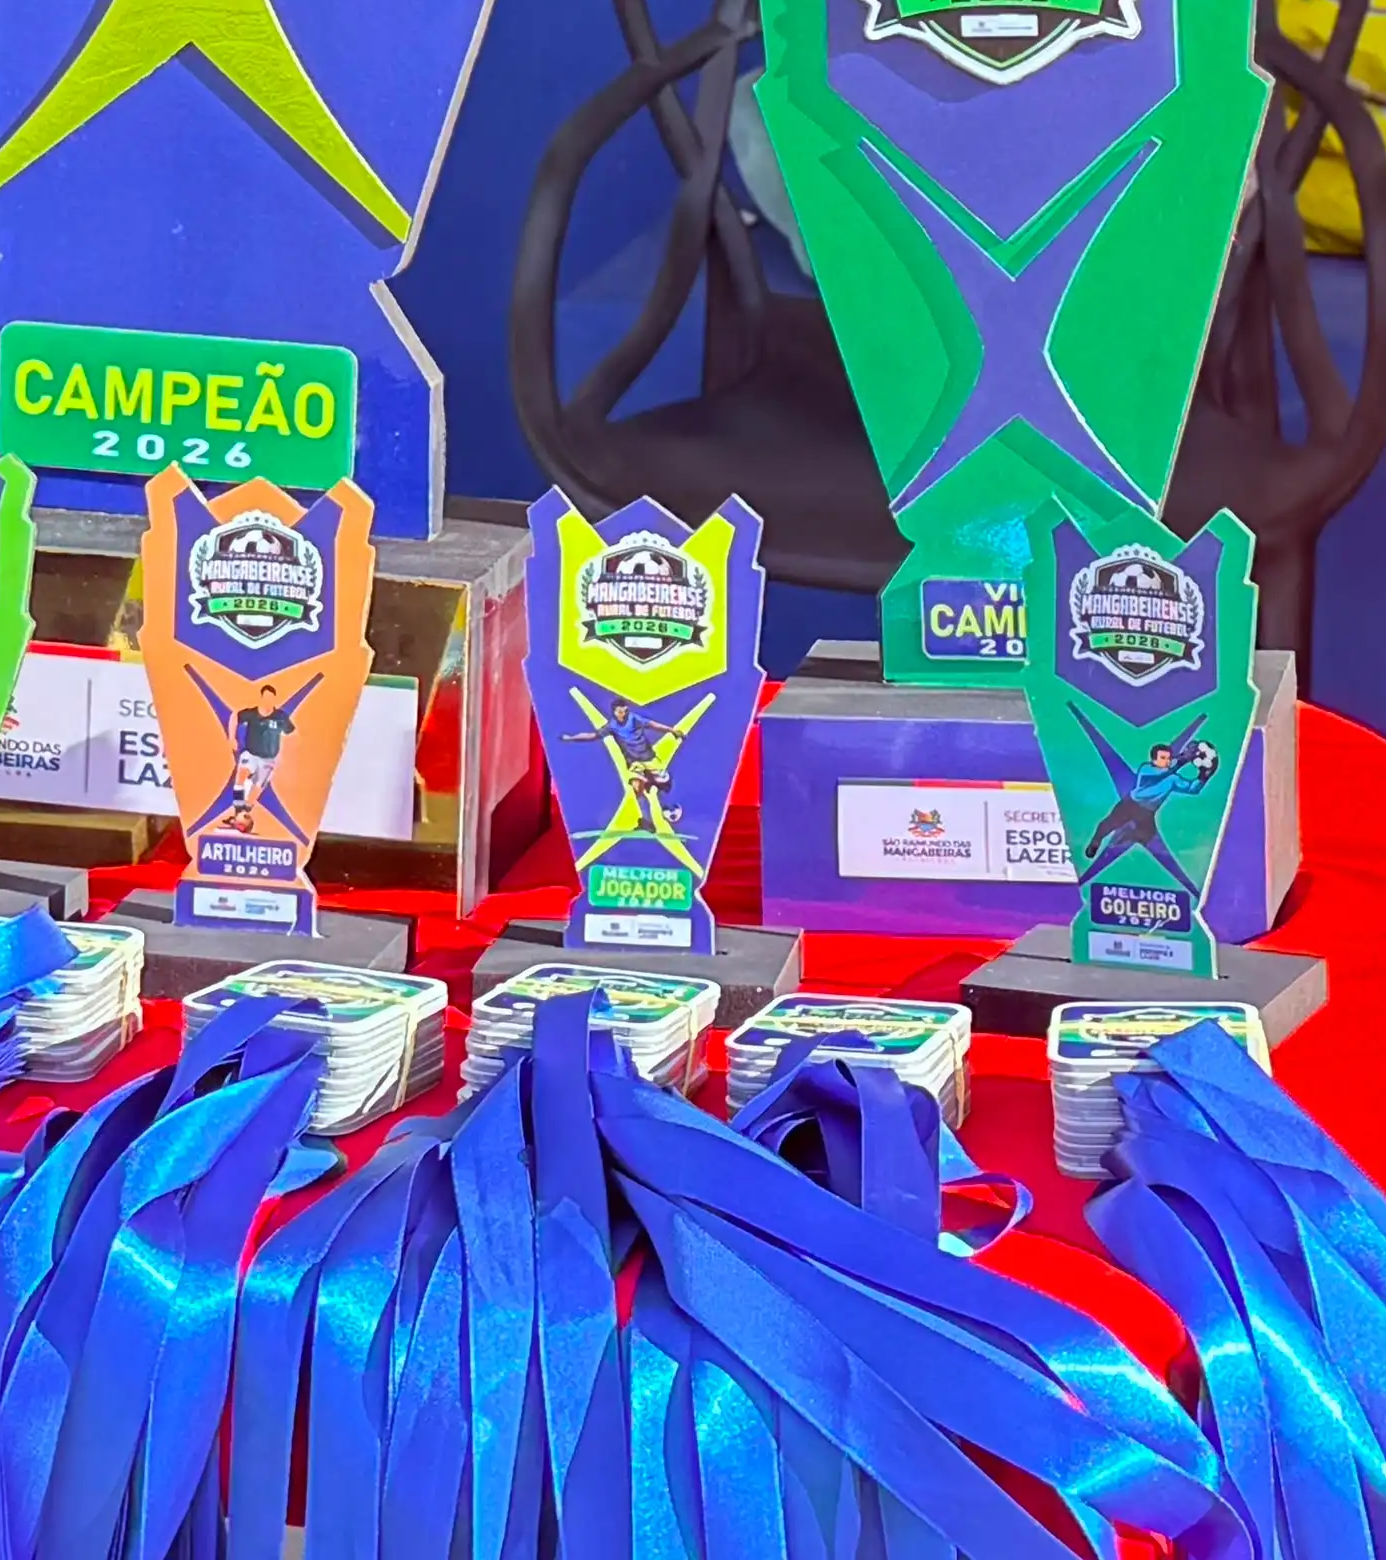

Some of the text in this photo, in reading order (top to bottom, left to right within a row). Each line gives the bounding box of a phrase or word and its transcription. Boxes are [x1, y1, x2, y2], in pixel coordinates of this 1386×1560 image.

[13, 359, 335, 439] CAMPEÃO
[91, 430, 252, 468] 2026
[201, 560, 314, 587] MANGABEIRENSE
[587, 581, 704, 607] MANGABEIRENSE
[983, 582, 1018, 602] VI
[1081, 593, 1195, 624] MANGABEIRENSE
[979, 639, 1024, 655] 20
[33, 741, 61, 756] DAS
[1004, 809, 1060, 823] SECRET
[1005, 829, 1063, 846] ESPO
[201, 842, 293, 866] ARTILHEIRO
[596, 880, 686, 900] JOGADOR
[1103, 886, 1177, 903] MELHOR
[1100, 897, 1181, 921] GOLEIRO
